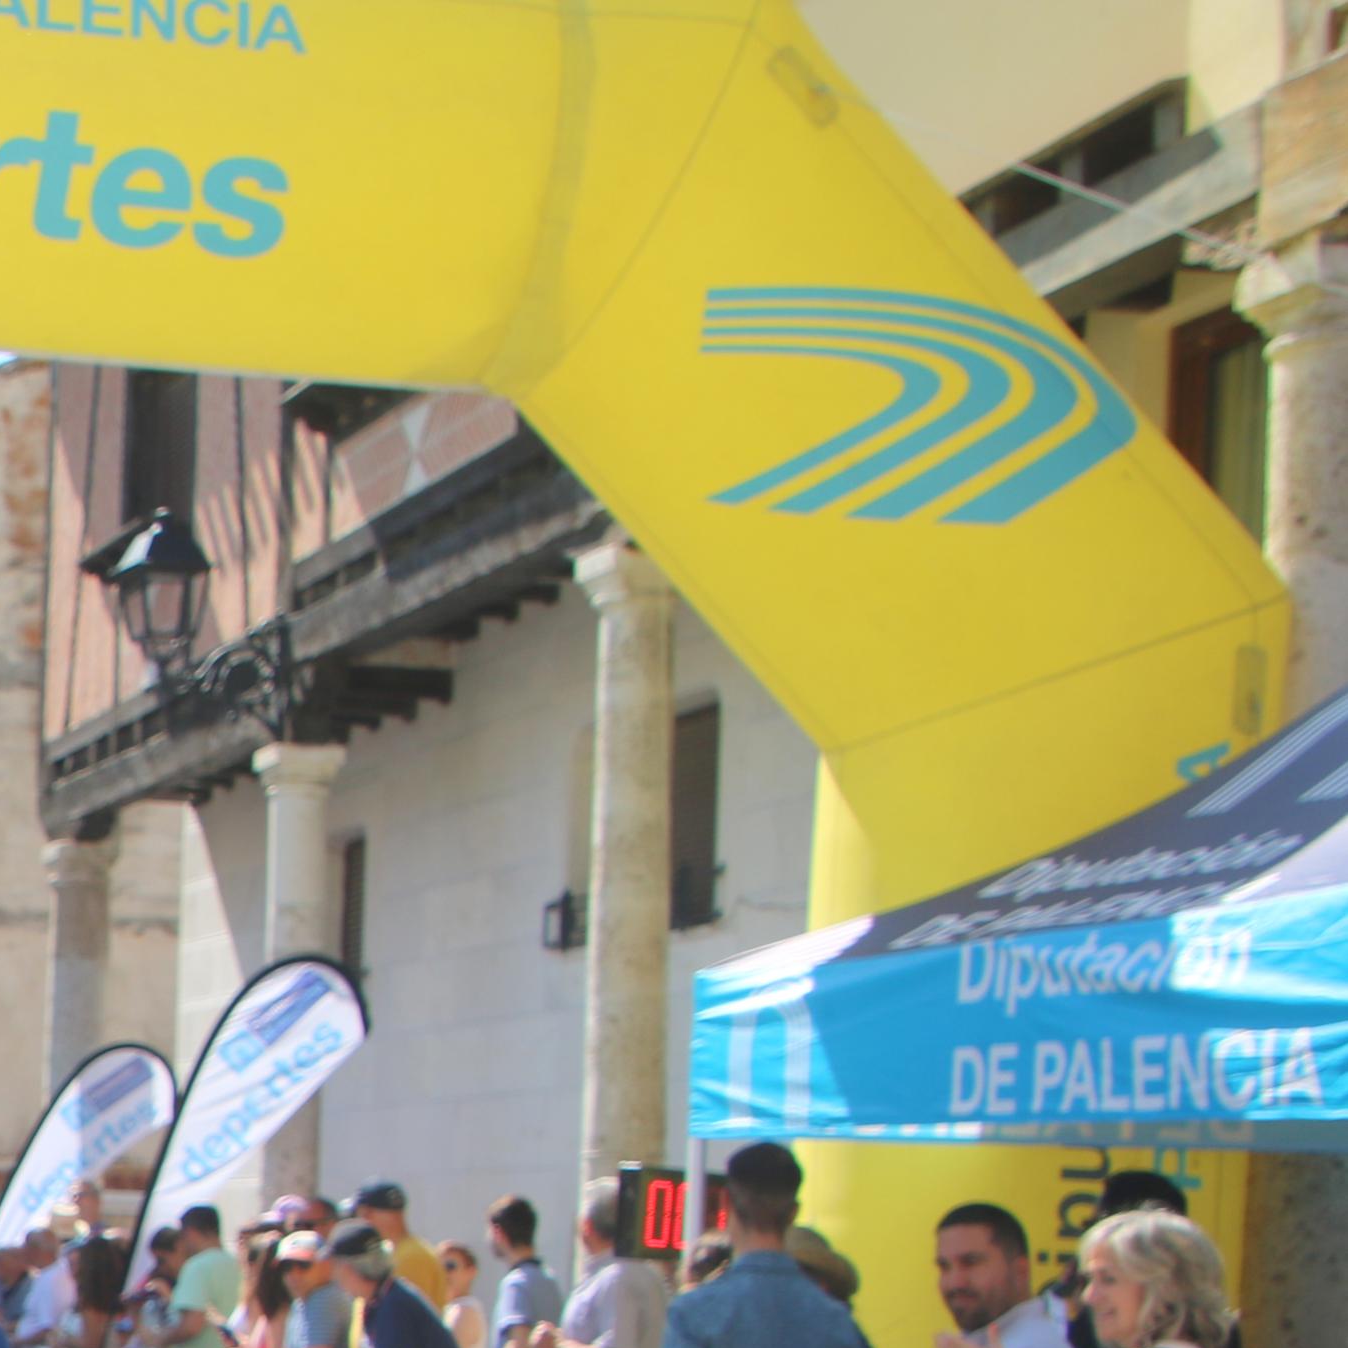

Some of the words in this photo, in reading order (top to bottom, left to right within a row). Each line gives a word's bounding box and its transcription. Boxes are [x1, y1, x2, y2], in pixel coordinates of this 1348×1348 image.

[956, 930, 1252, 1019] Diputación
[181, 1020, 344, 1181] deportes
[948, 1044, 1018, 1116] DE
[1031, 1027, 1325, 1113] PALENCIA
